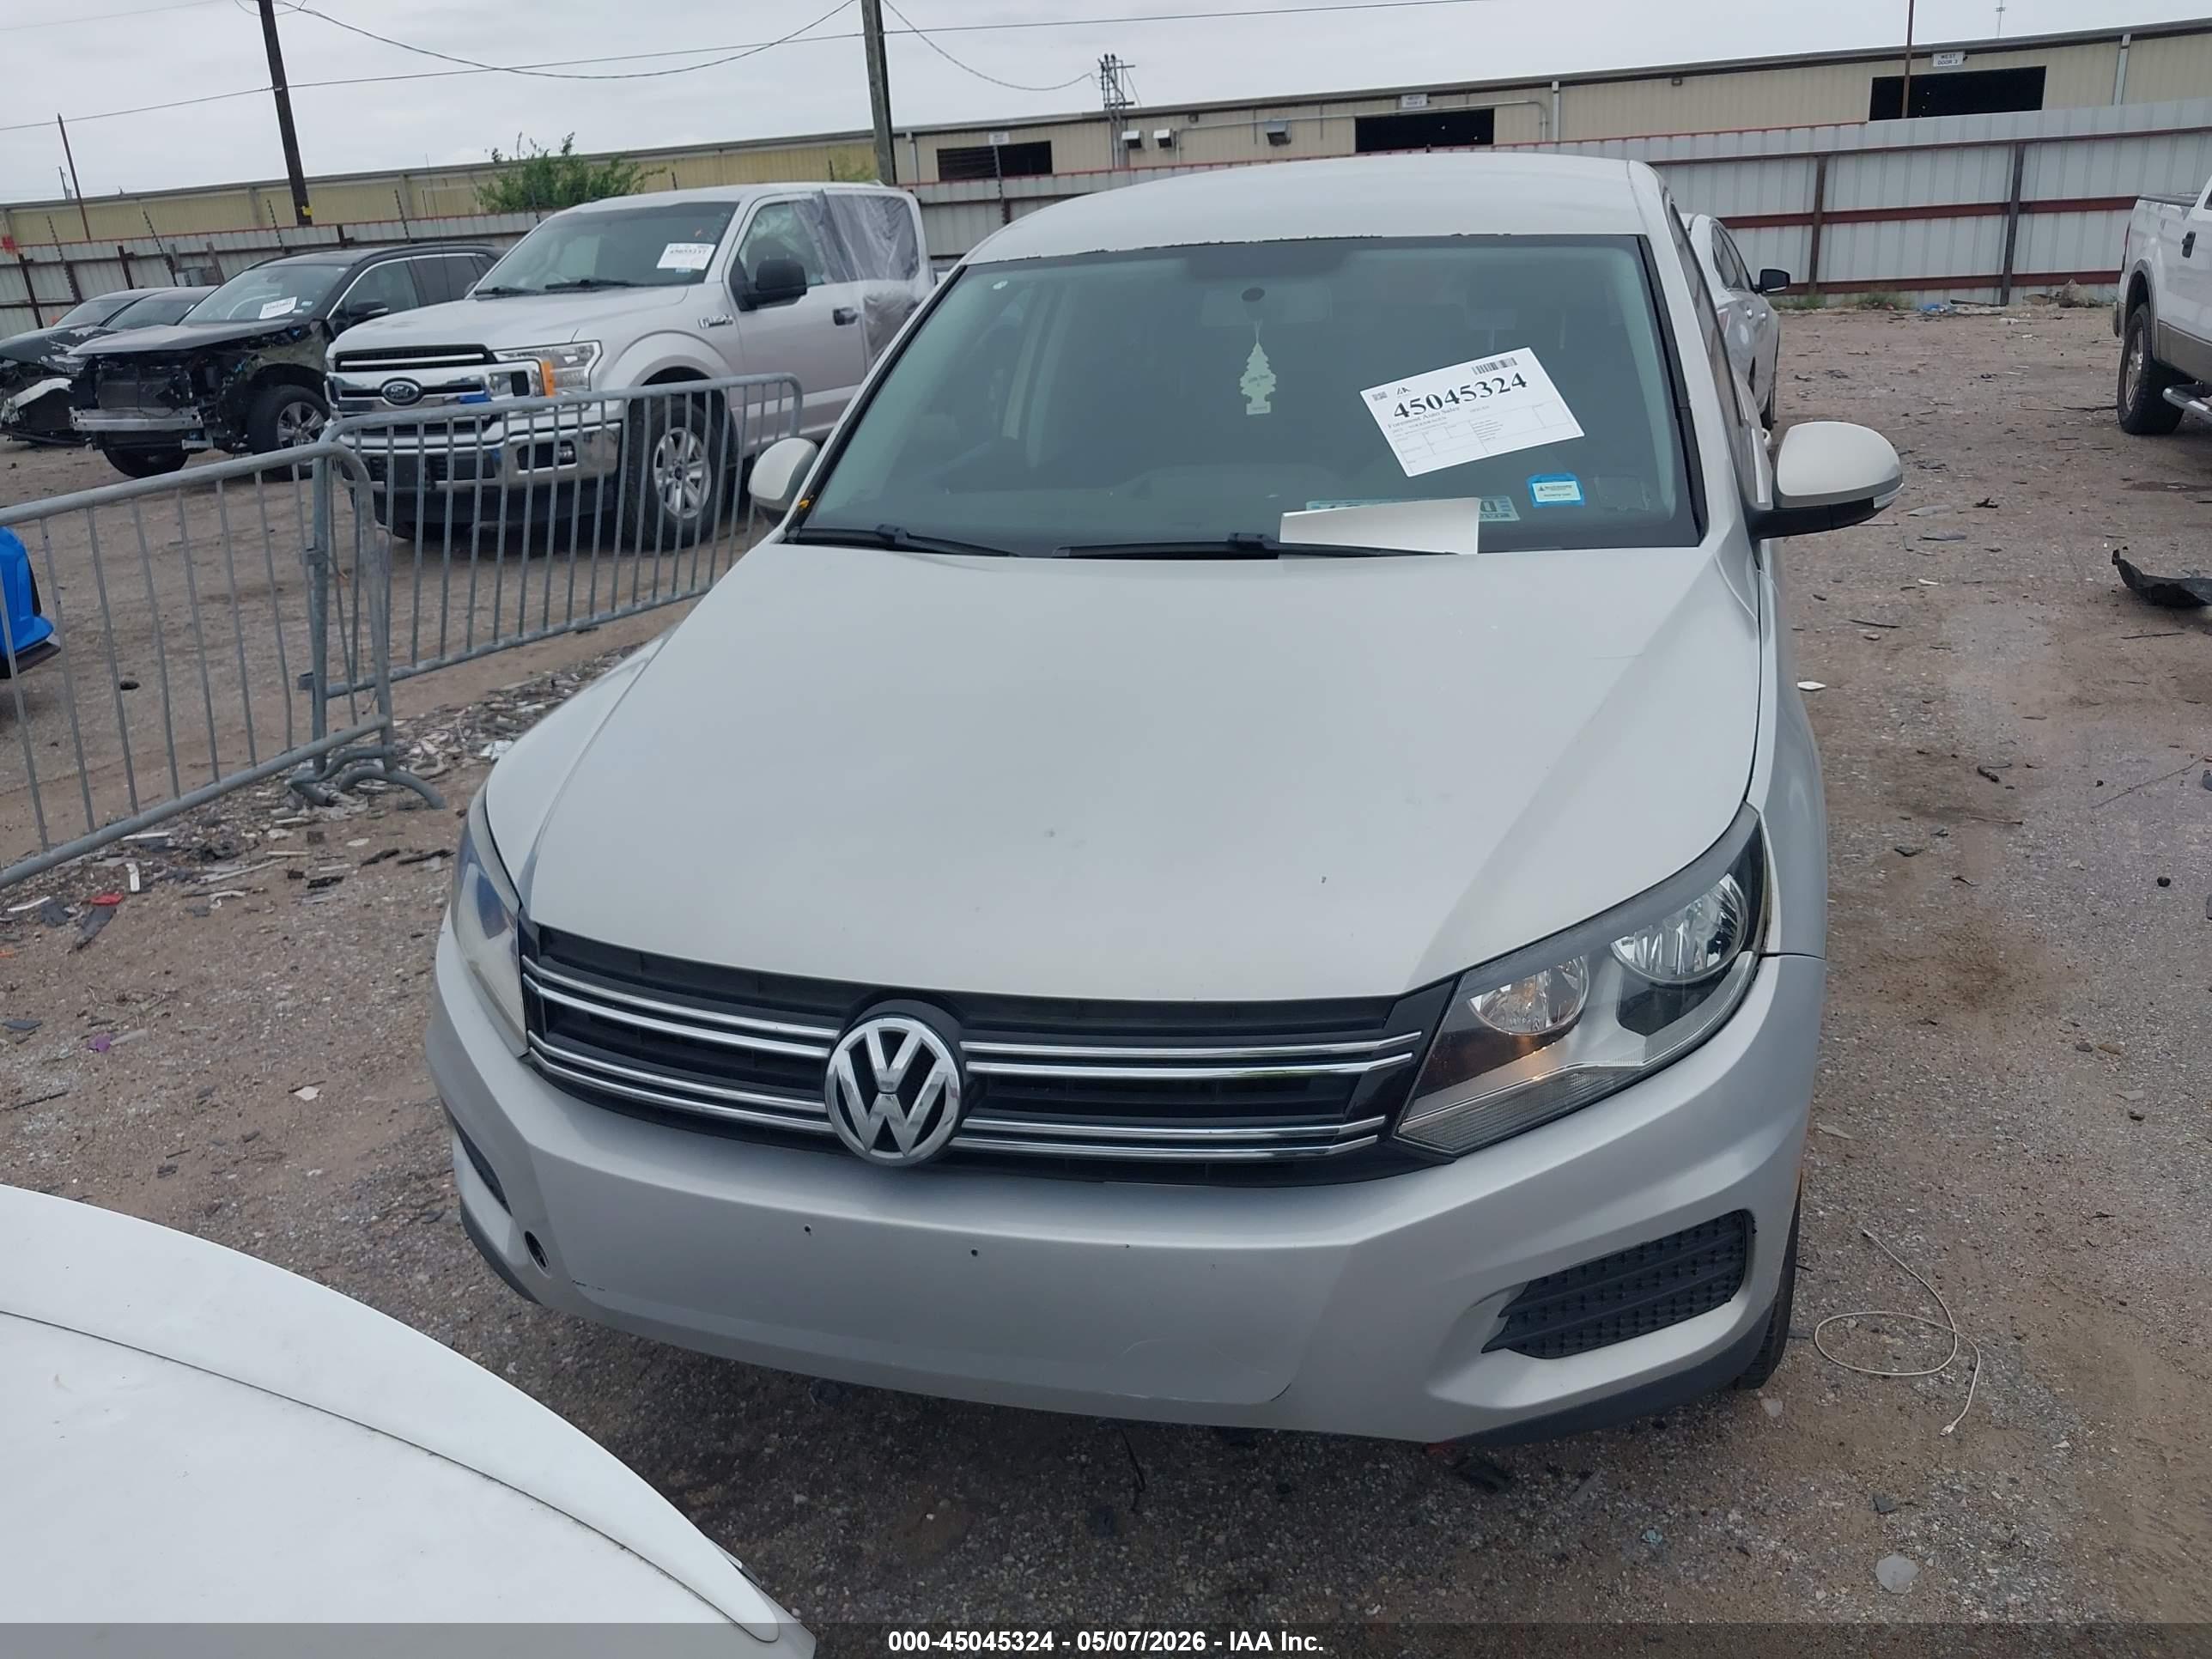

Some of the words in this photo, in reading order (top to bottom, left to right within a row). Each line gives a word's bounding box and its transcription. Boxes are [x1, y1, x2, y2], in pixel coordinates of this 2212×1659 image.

[1394, 372, 1527, 418] 45045324
[1423, 410, 1441, 420] Auto
[1442, 406, 1460, 415] Sales
